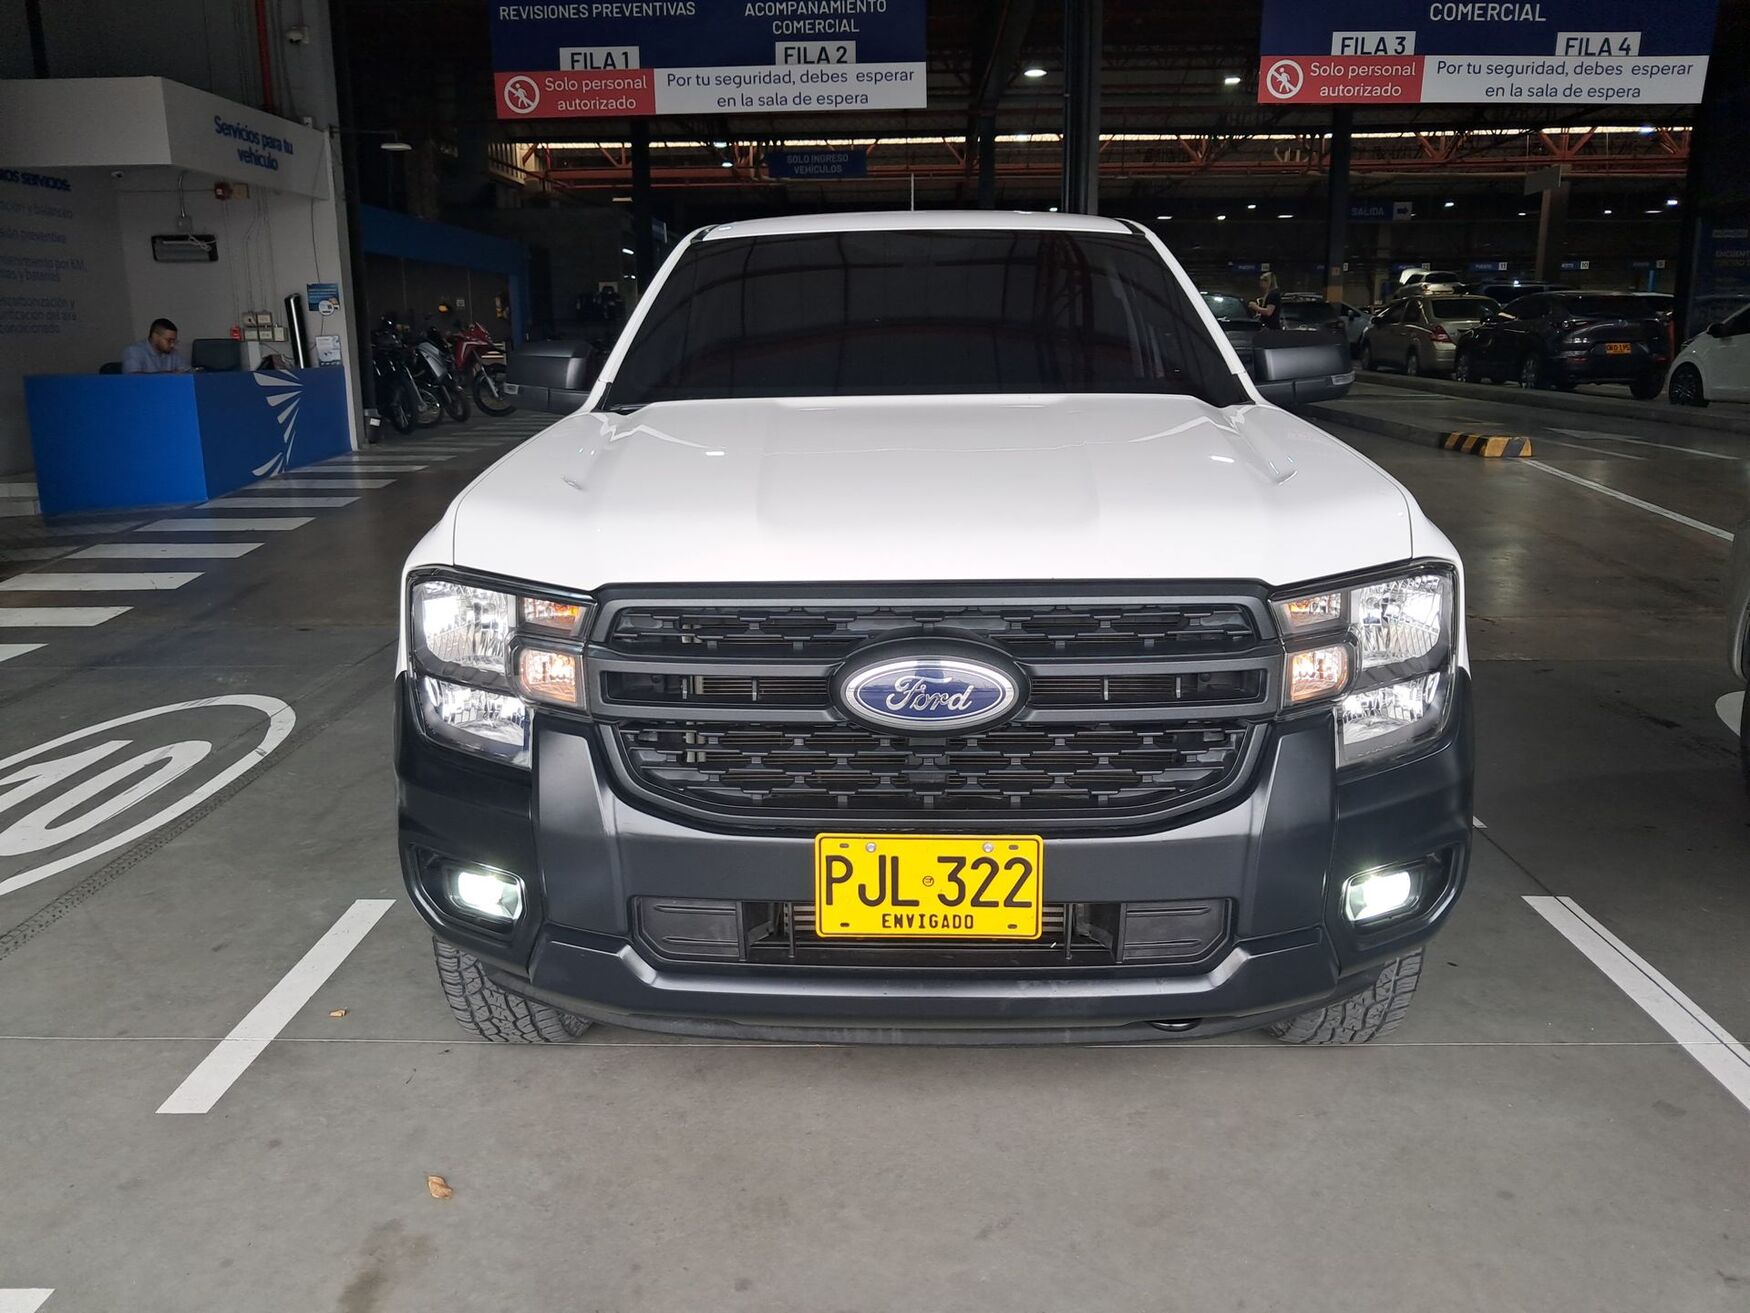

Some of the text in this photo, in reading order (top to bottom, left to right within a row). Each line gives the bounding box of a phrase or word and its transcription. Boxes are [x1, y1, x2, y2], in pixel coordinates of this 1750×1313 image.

[499, 1, 696, 20] REVISIONES PREVENTIVAS
[1429, 3, 1547, 22] COMERCIAL
[772, 18, 860, 34] COMERCIAL
[784, 45, 848, 65] FILA 2
[1341, 36, 1406, 55] FILA 3
[1565, 37, 1631, 56] FILA 4
[571, 51, 629, 70] FILA 1
[1437, 61, 1693, 78] Por tu seguridad, debes esperar
[667, 69, 915, 89] Por tu seguridad, debes esperar
[1310, 62, 1416, 79] Solo personal
[545, 75, 647, 93] Solo personal
[1320, 83, 1402, 97] autorizado
[1485, 83, 1641, 100] en la sala de espera
[557, 96, 637, 111] autorizado
[716, 91, 869, 108] en la sala de espera
[214, 115, 294, 155] Servicios para tu
[885, 674, 976, 712] Ford
[825, 854, 1033, 908] PJL 322
[881, 912, 975, 930] ENVIGADO
